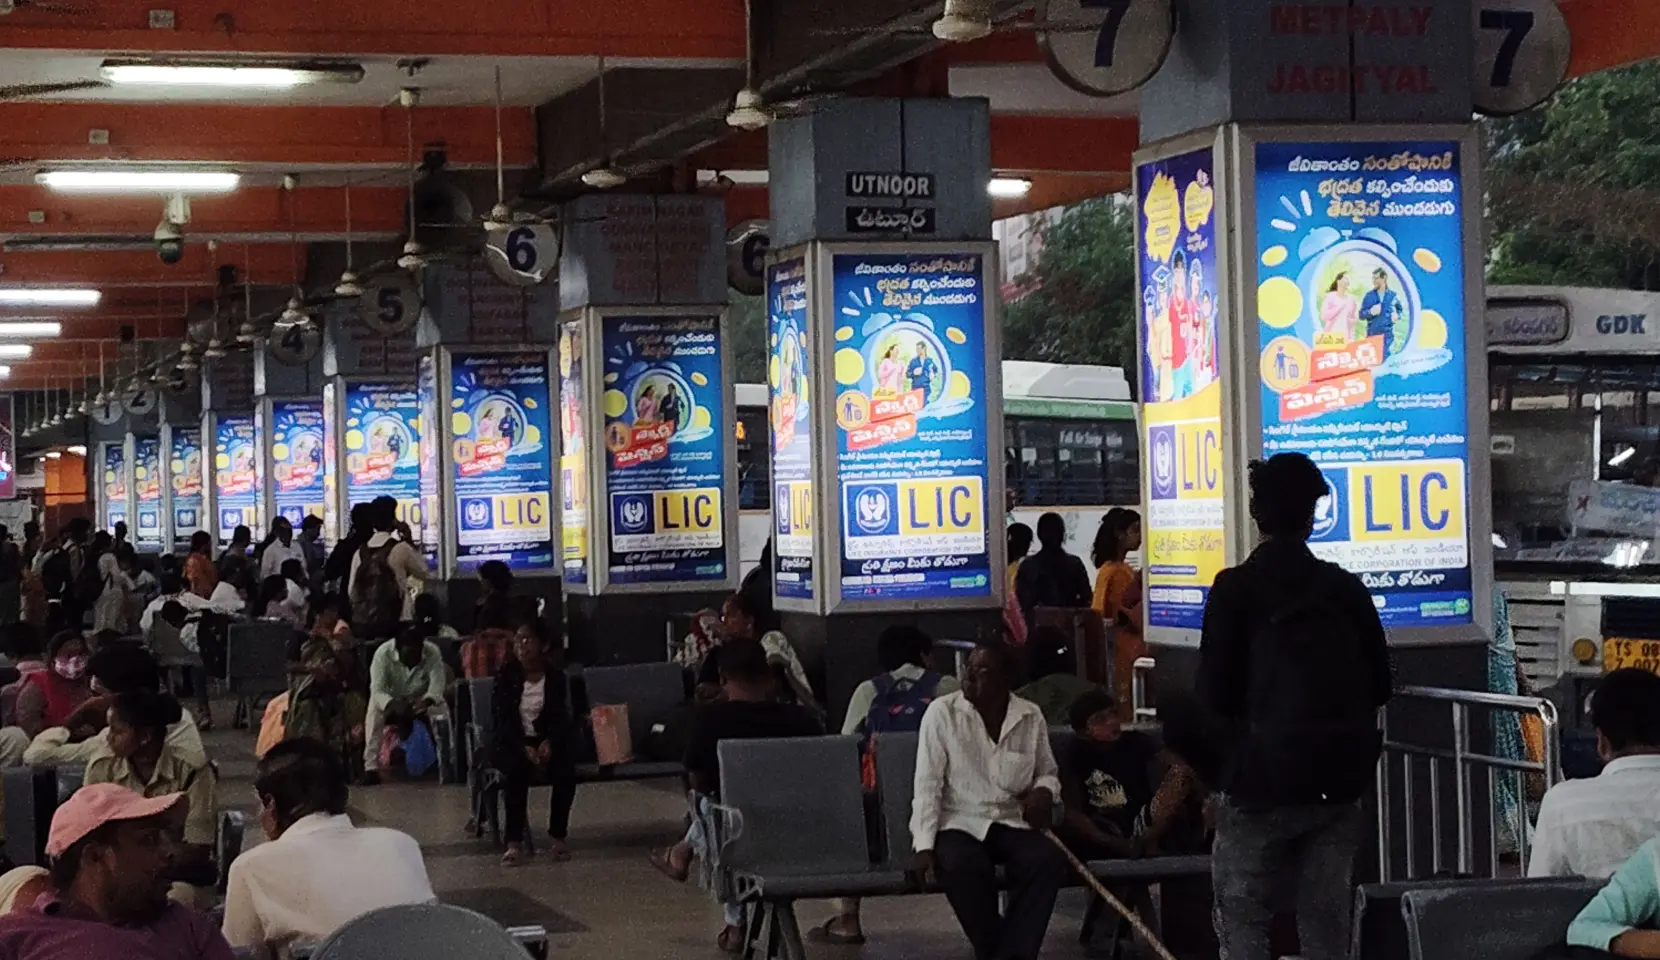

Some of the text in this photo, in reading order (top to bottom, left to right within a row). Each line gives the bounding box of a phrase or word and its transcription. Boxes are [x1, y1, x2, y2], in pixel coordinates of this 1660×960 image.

[1081, 0, 1131, 67] 7
[1480, 10, 1534, 87] 7
[851, 174, 930, 195] UTNOOR
[506, 226, 537, 271] 6
[743, 233, 771, 277] 6
[376, 287, 400, 324] 5
[1596, 315, 1647, 334] GDK
[282, 323, 305, 350] 4
[1181, 429, 1217, 490] LIC
[500, 497, 542, 525] LIC
[661, 494, 712, 529] LIC
[793, 488, 811, 530] LIC
[908, 485, 972, 529] LIC
[1364, 471, 1450, 532] LIC
[1357, 556, 1465, 570] CORPORATION OF INDIA
[1614, 639, 1632, 657] TS
